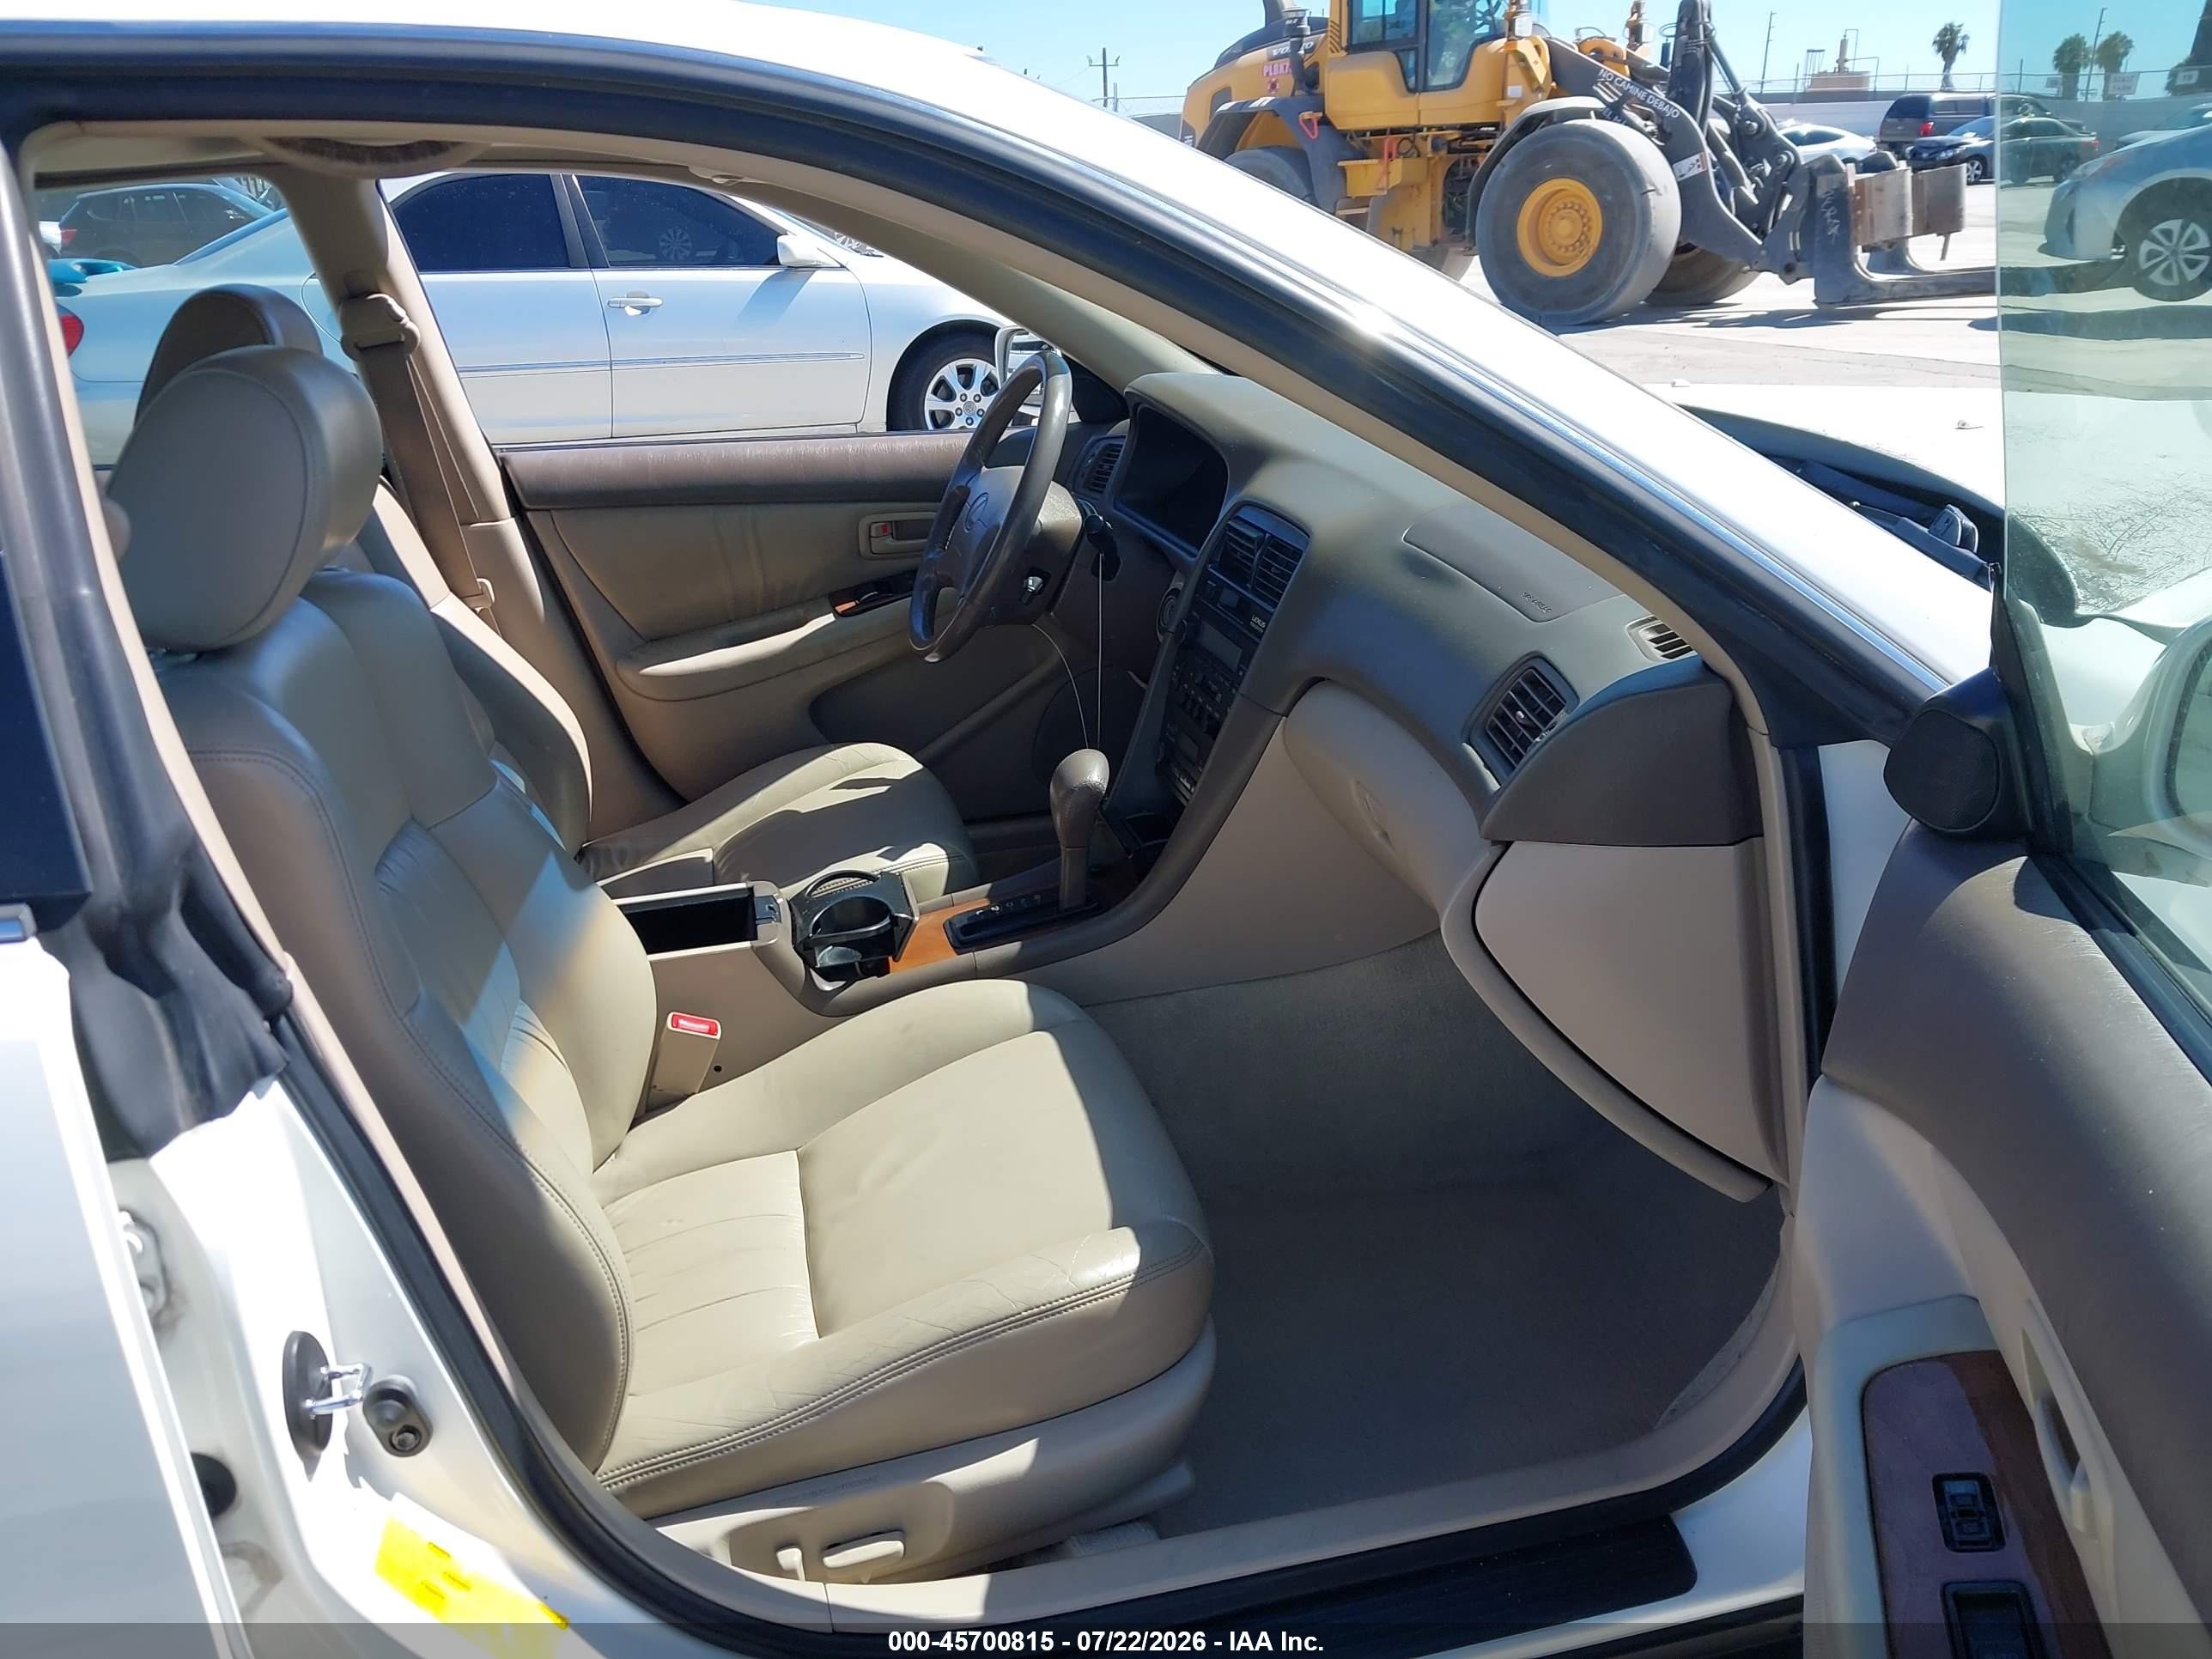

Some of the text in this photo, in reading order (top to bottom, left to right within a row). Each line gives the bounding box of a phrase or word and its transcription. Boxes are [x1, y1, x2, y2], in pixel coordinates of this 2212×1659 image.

[1598, 69, 1680, 118] NO CAMINE DEBAJO
[1251, 614, 1267, 629] LEXUS
